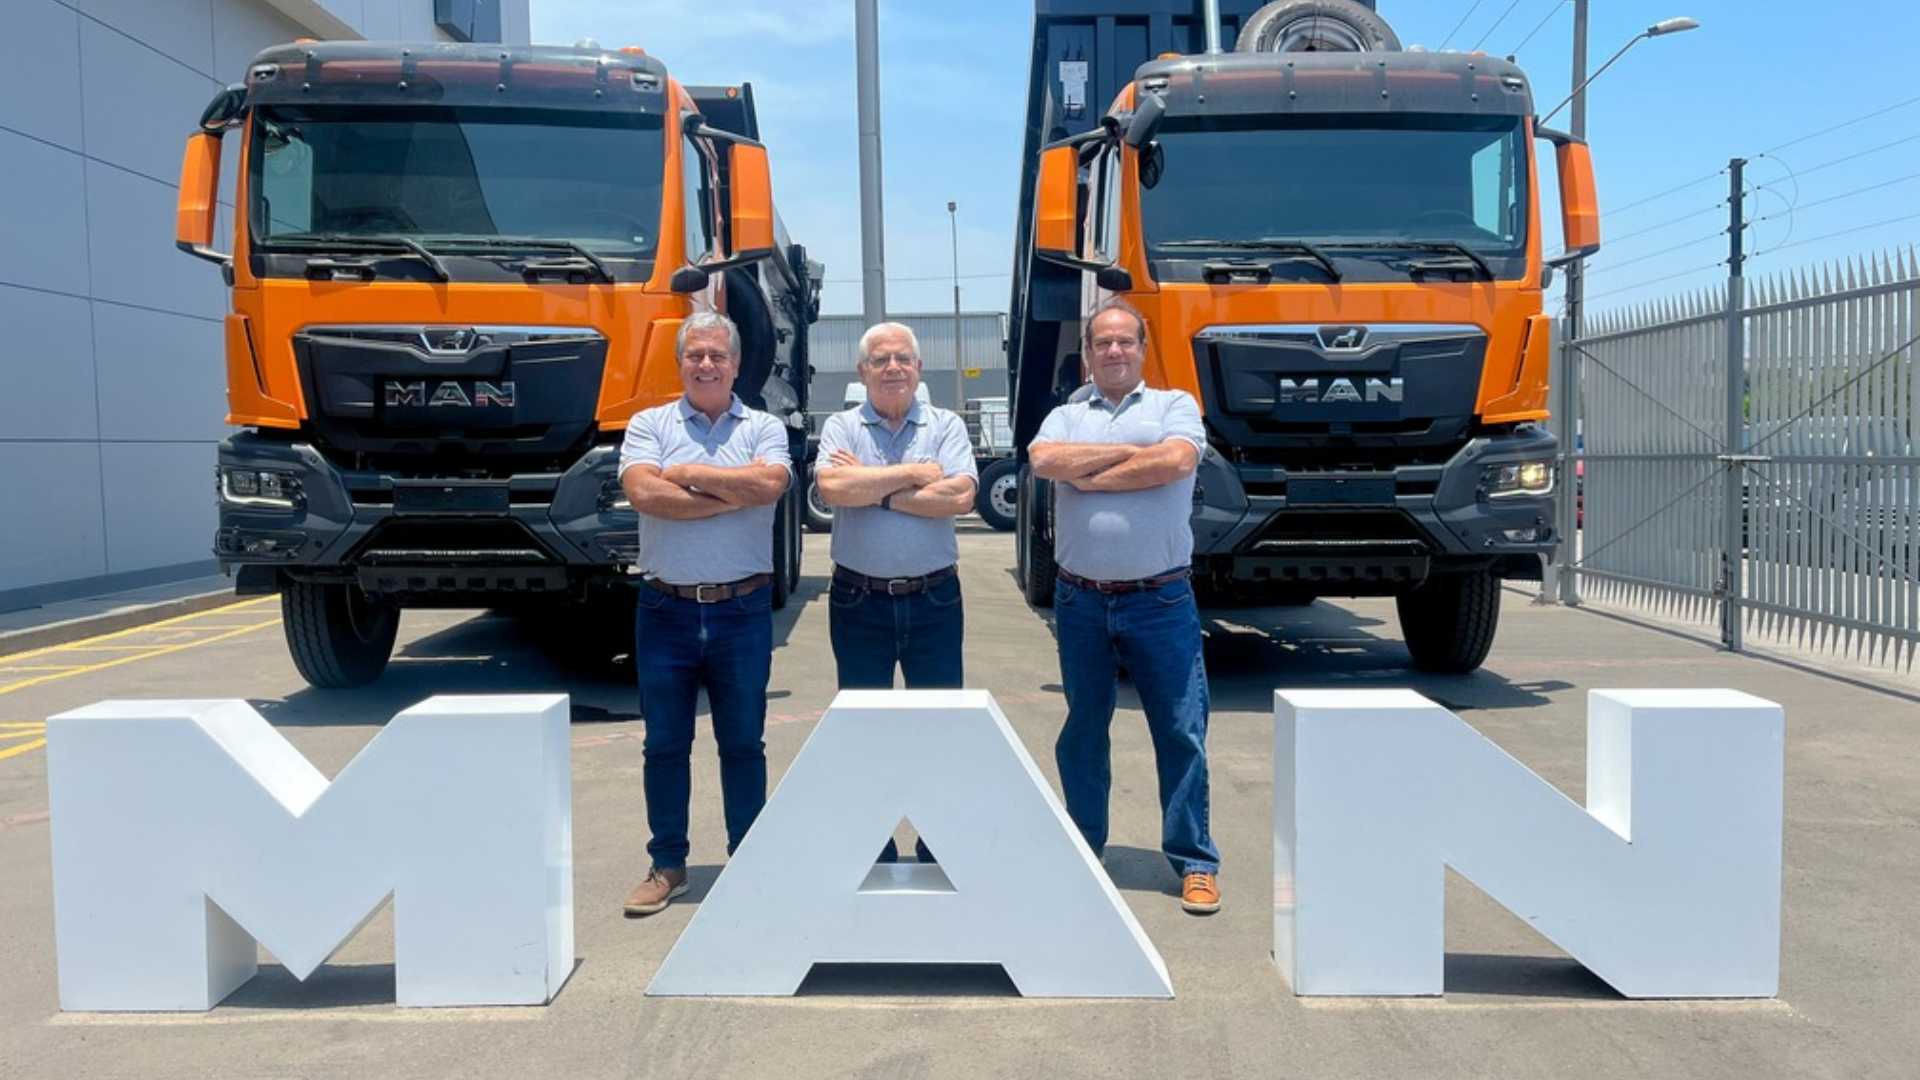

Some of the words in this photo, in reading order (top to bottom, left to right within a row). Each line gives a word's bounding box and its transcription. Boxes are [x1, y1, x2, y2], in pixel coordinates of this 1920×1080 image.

[384, 380, 516, 407] MAN
[1280, 378, 1404, 402] MAN
[46, 688, 1784, 1011] MAN
